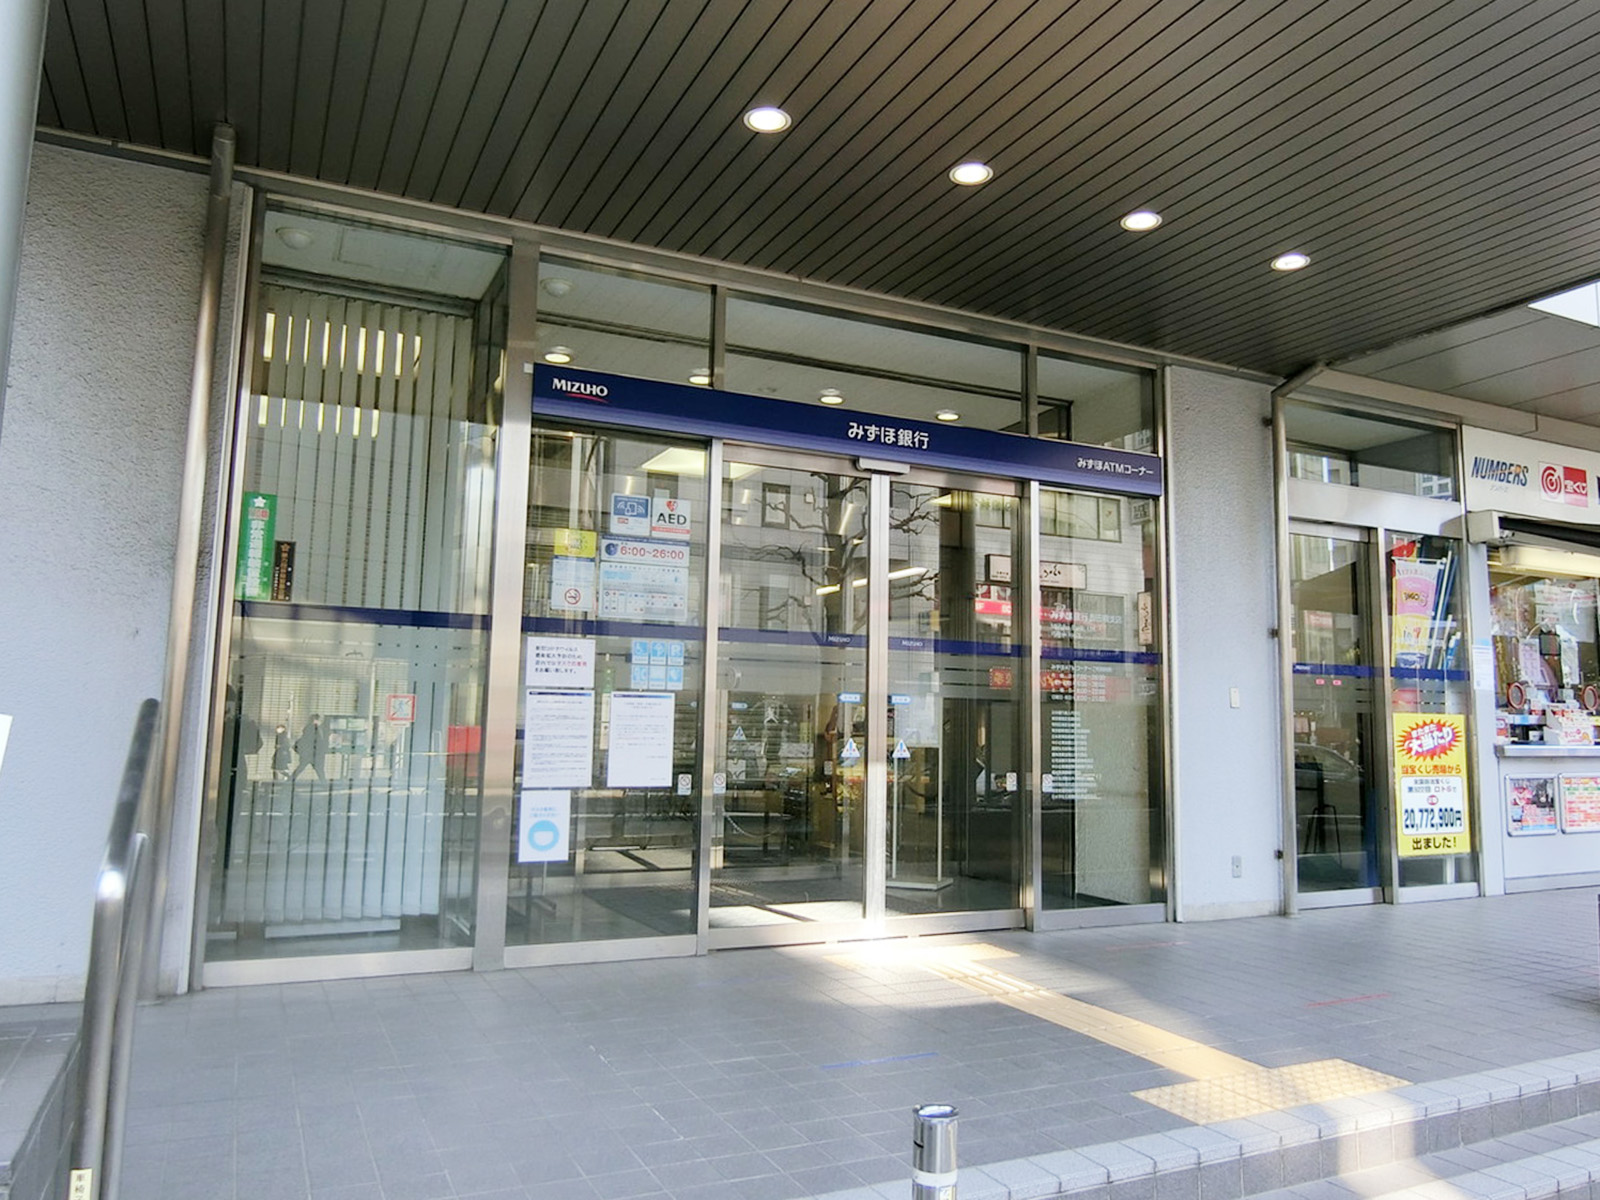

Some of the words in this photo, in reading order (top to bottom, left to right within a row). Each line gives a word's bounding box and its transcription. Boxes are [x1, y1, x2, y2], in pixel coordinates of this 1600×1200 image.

[552, 378, 609, 398] MIZUHO
[847, 422, 930, 450] みずほ銀行
[1076, 457, 1154, 477] みずほATMコーナー
[1471, 456, 1529, 487] NUMBERS
[657, 513, 687, 526] AED
[1405, 726, 1453, 756] 大当たり
[1401, 764, 1462, 775] 当宝くじ売場から
[1404, 807, 1463, 831] 20,772,900円
